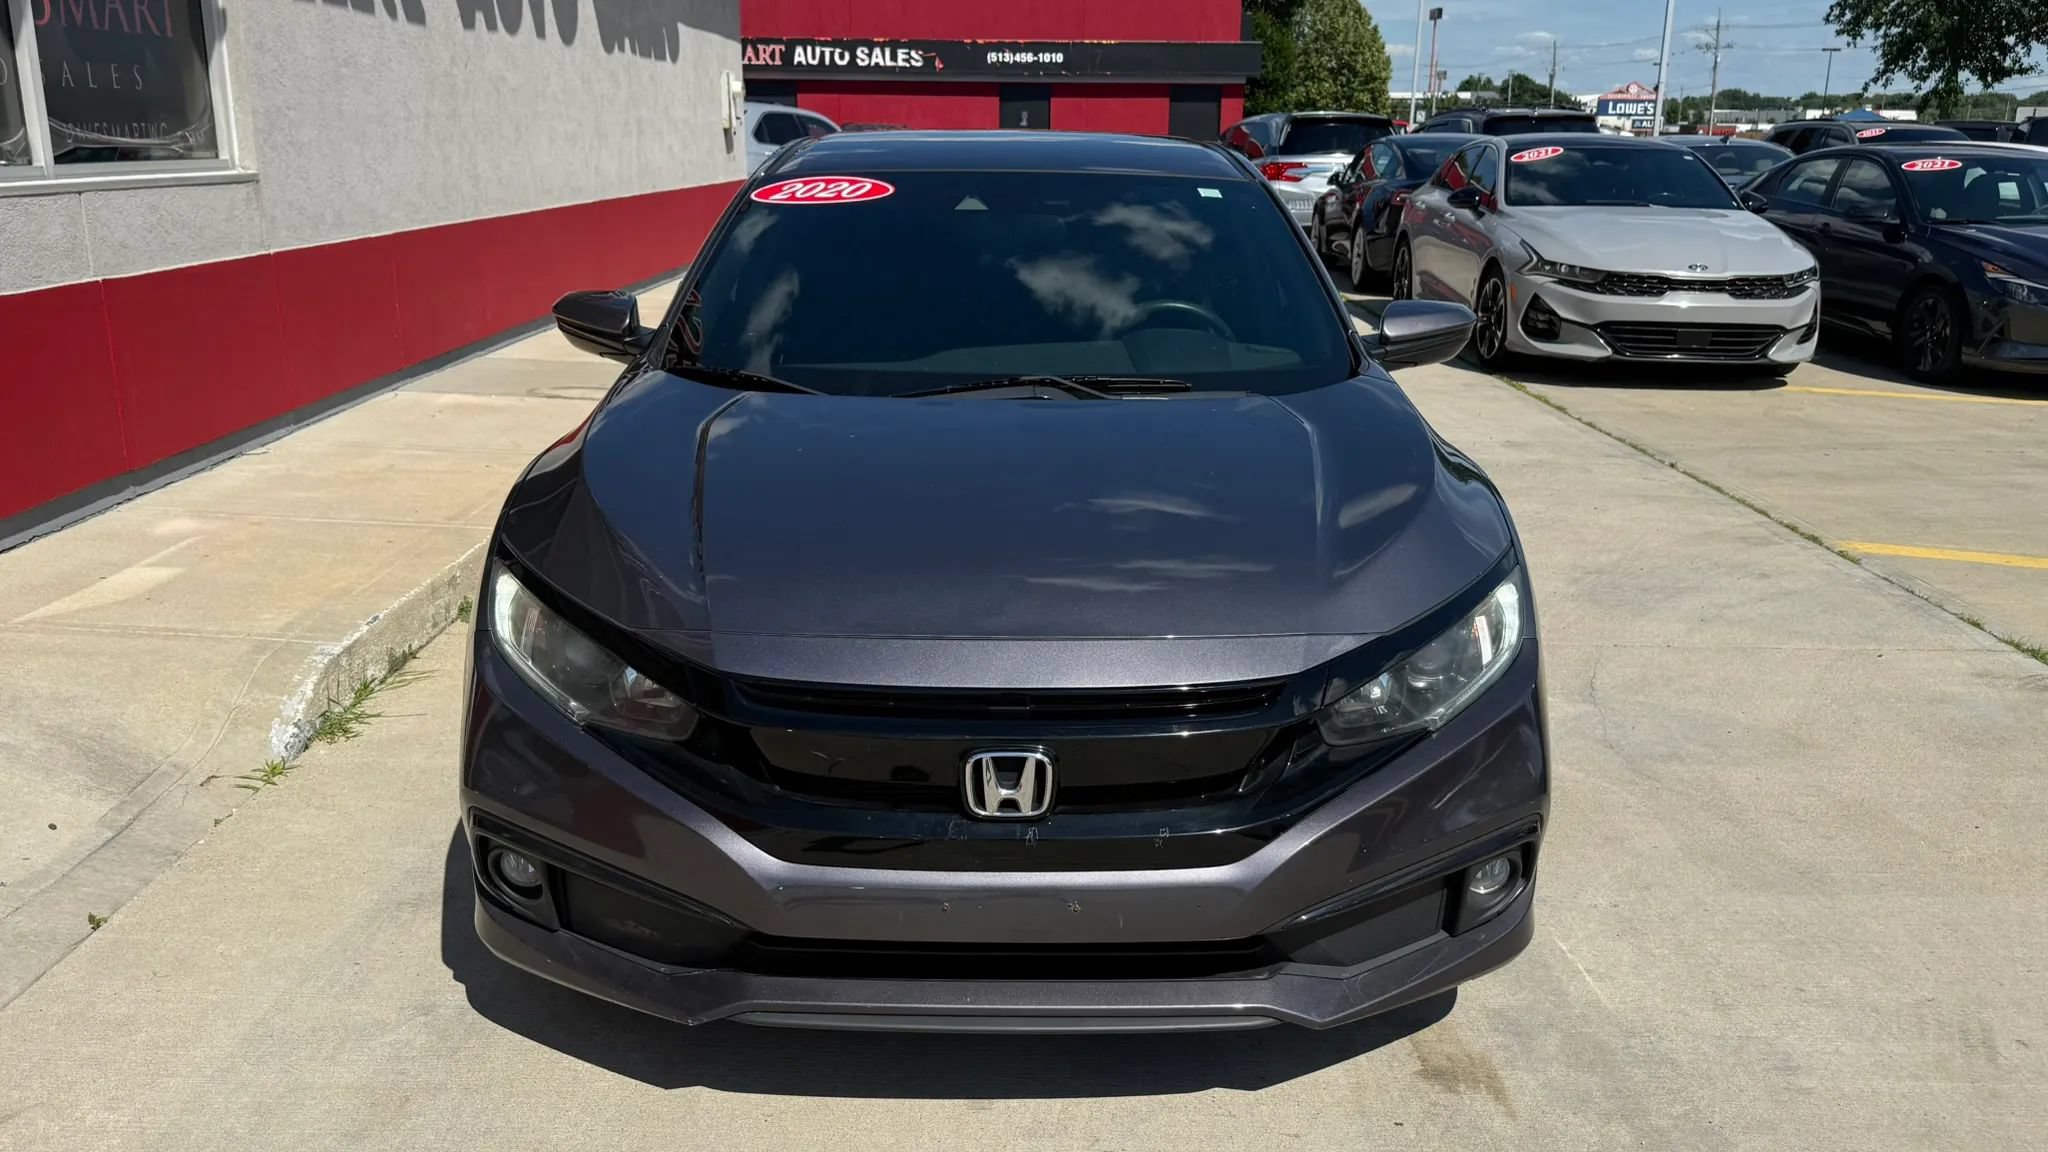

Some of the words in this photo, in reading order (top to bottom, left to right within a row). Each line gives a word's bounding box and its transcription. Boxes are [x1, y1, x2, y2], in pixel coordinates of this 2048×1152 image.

[794, 45, 850, 66] AUTO
[856, 46, 924, 67] SALES
[987, 52, 1064, 64] (513)456-1010
[1608, 101, 1655, 114] LOWE'S
[1914, 161, 1949, 169] 2021
[768, 181, 872, 200] 2020
